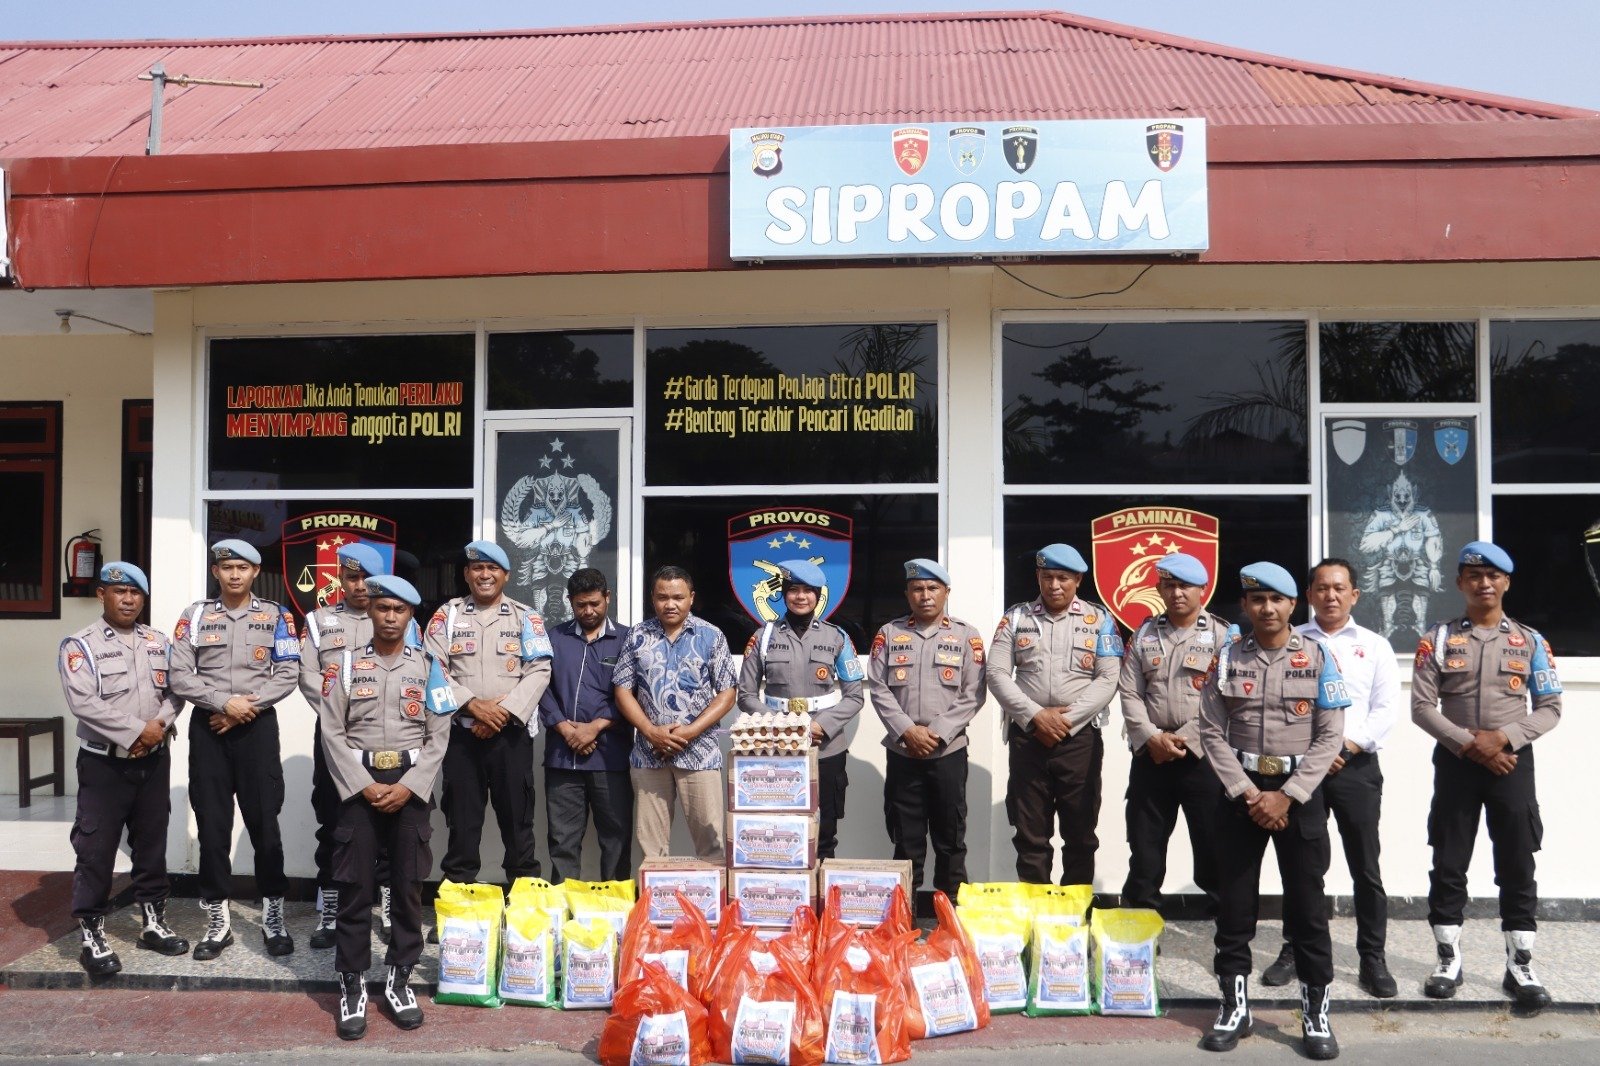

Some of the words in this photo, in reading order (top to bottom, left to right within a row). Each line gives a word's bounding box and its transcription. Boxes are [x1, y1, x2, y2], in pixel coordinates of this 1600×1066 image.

[765, 179, 1170, 245] SIPROPAM
[227, 385, 303, 408] LAPORKAN
[303, 382, 324, 408] Jika
[326, 382, 351, 407] Anda
[354, 382, 399, 407] Temukan
[399, 382, 463, 406] PERILAKU
[663, 374, 718, 400] #Garda
[722, 374, 774, 405] Terdepan
[829, 373, 862, 400] Citra
[865, 372, 915, 399] POLRI
[227, 412, 348, 438] MENYIMPANG
[351, 415, 407, 445] anggota
[410, 411, 462, 437] POLRI
[664, 406, 736, 438] #Benteng
[739, 405, 794, 432] Terakhir
[798, 405, 848, 432] Pencari
[853, 405, 914, 432] Keadilan
[301, 513, 379, 532] PROPAM
[749, 511, 831, 528] PROVOS
[1111, 507, 1198, 529] PAMINAL
[200, 623, 227, 631] ARIFIN
[248, 623, 275, 632] POLRI
[813, 644, 835, 653] POLRI
[891, 644, 914, 652] IKMAL
[937, 644, 962, 653] POLRI
[1502, 648, 1529, 658] POLRI
[351, 676, 378, 685] AFDAL
[1285, 669, 1317, 679] POLRI
